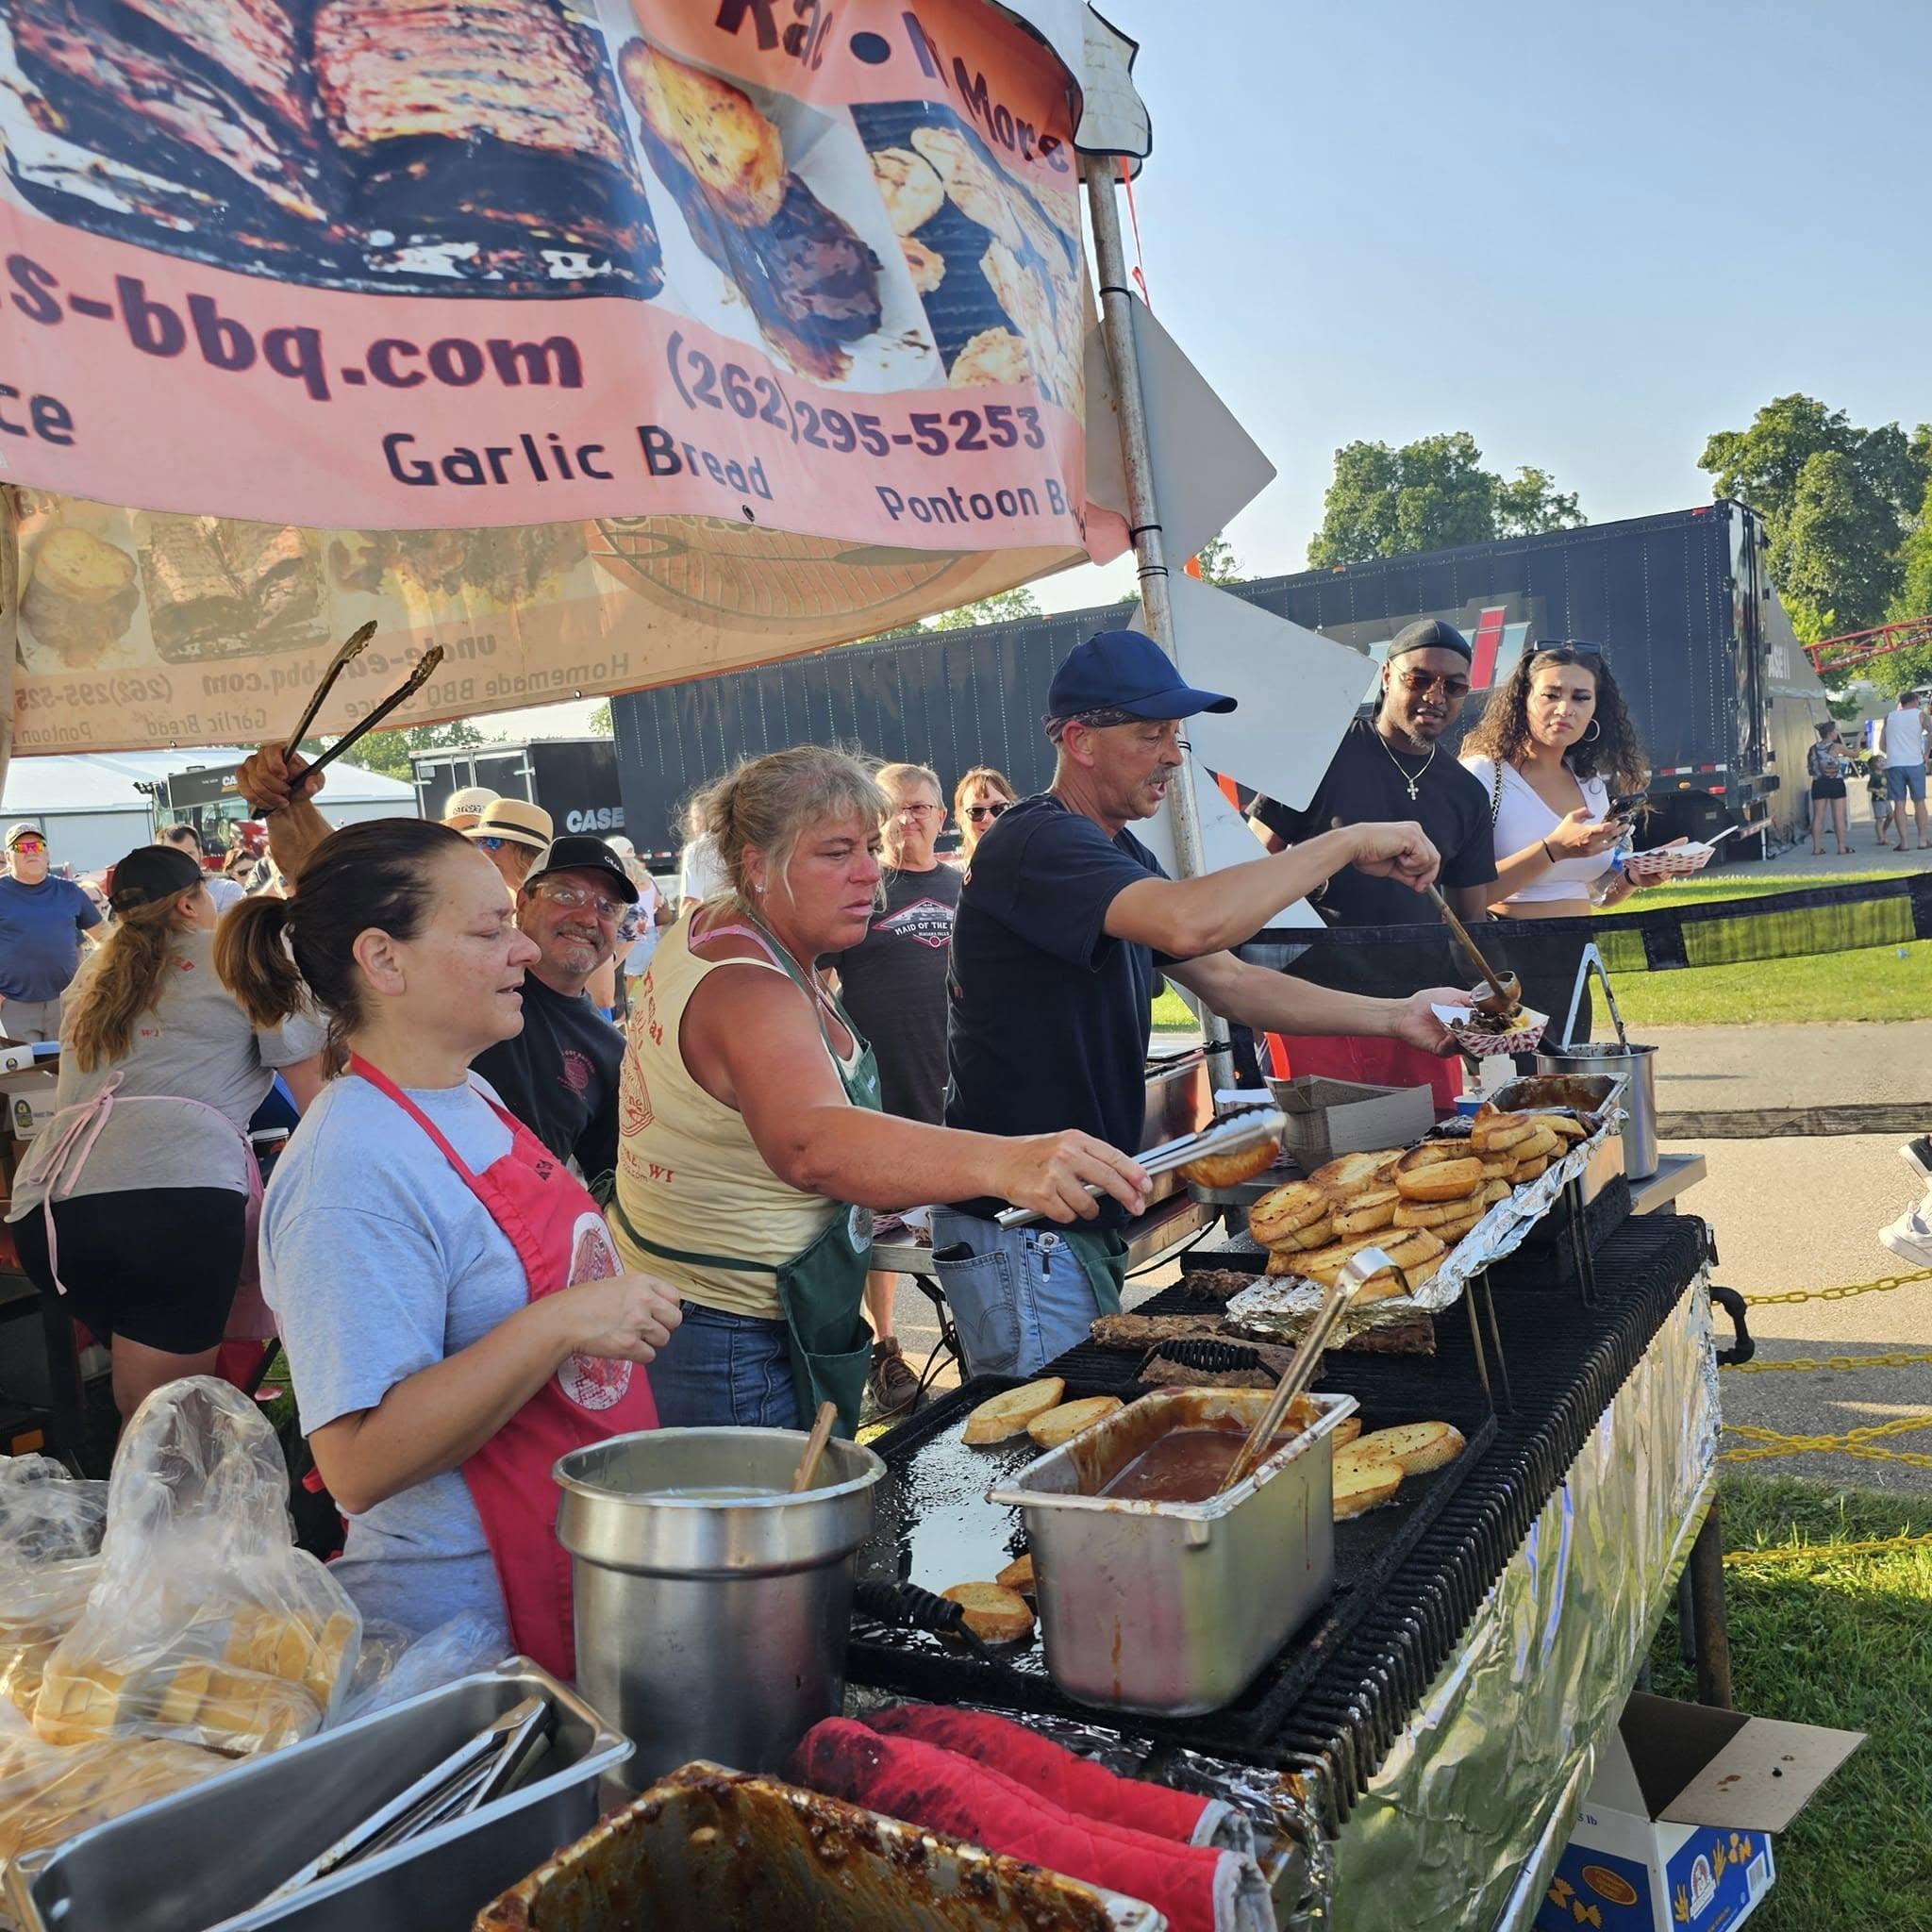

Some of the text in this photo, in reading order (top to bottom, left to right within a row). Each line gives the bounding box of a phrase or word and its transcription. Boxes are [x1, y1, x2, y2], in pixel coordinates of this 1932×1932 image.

[952, 57, 1070, 174] More
[667, 330, 1045, 457] (262)295-5253
[381, 424, 774, 501] Garlic Bread
[874, 485, 1039, 523] Pontoon
[222, 775, 238, 786] CA
[566, 807, 625, 833] CASE
[894, 923, 917, 936] MAID
[918, 921, 928, 930] OF
[931, 921, 947, 930] THE
[649, 1163, 675, 1183] WI
[1586, 1814, 1597, 1825] lb
